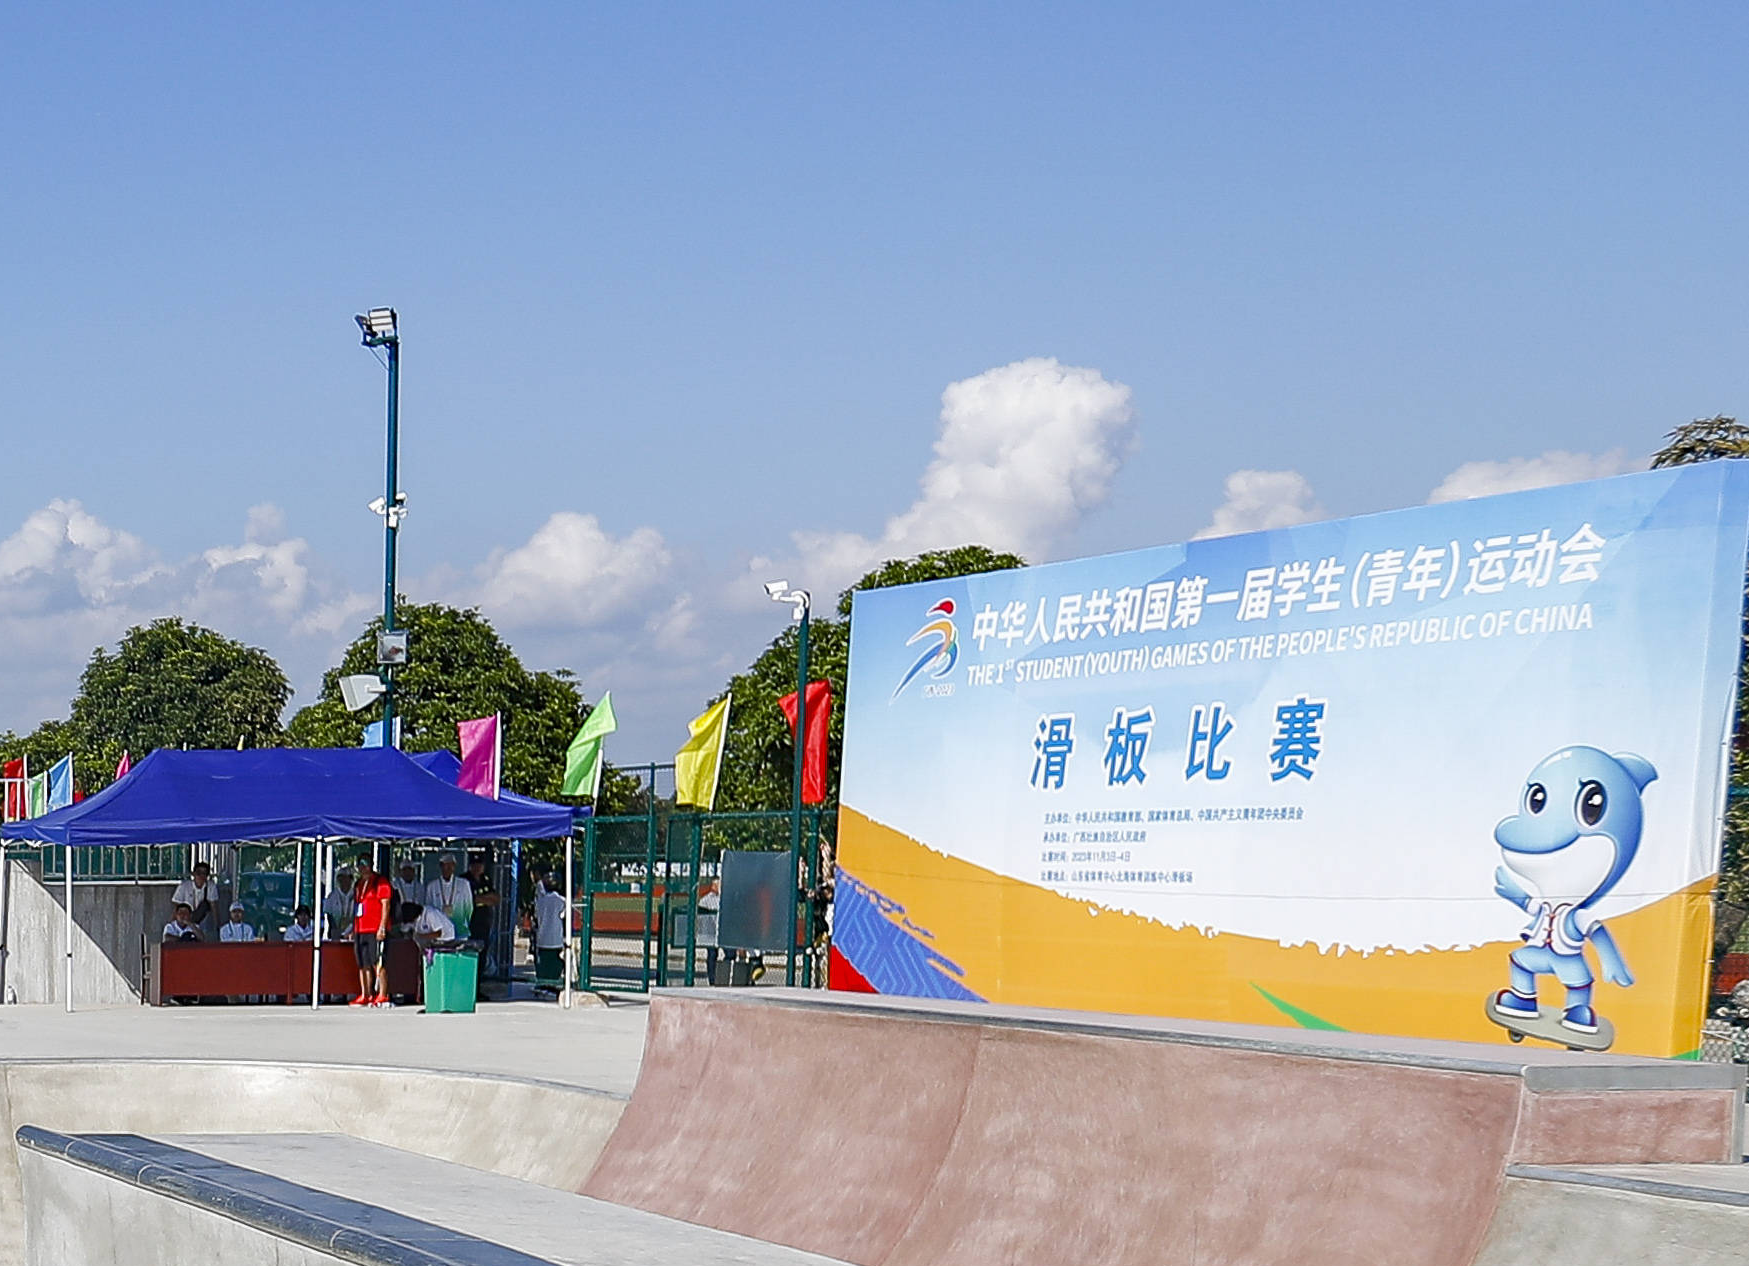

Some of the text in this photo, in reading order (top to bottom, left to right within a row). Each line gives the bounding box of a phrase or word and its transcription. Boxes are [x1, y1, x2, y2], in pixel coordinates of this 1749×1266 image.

[971, 523, 1606, 651] 中华人民共和国第一届学生（青年）运动会
[967, 664, 996, 686] THE
[1210, 638, 1237, 663] OF
[1237, 633, 1276, 661] THE
[1276, 624, 1368, 657] PEOPLE'S
[1369, 614, 1477, 648] REPUBLIC
[1478, 610, 1513, 638] OF
[1514, 603, 1594, 635] CHINA
